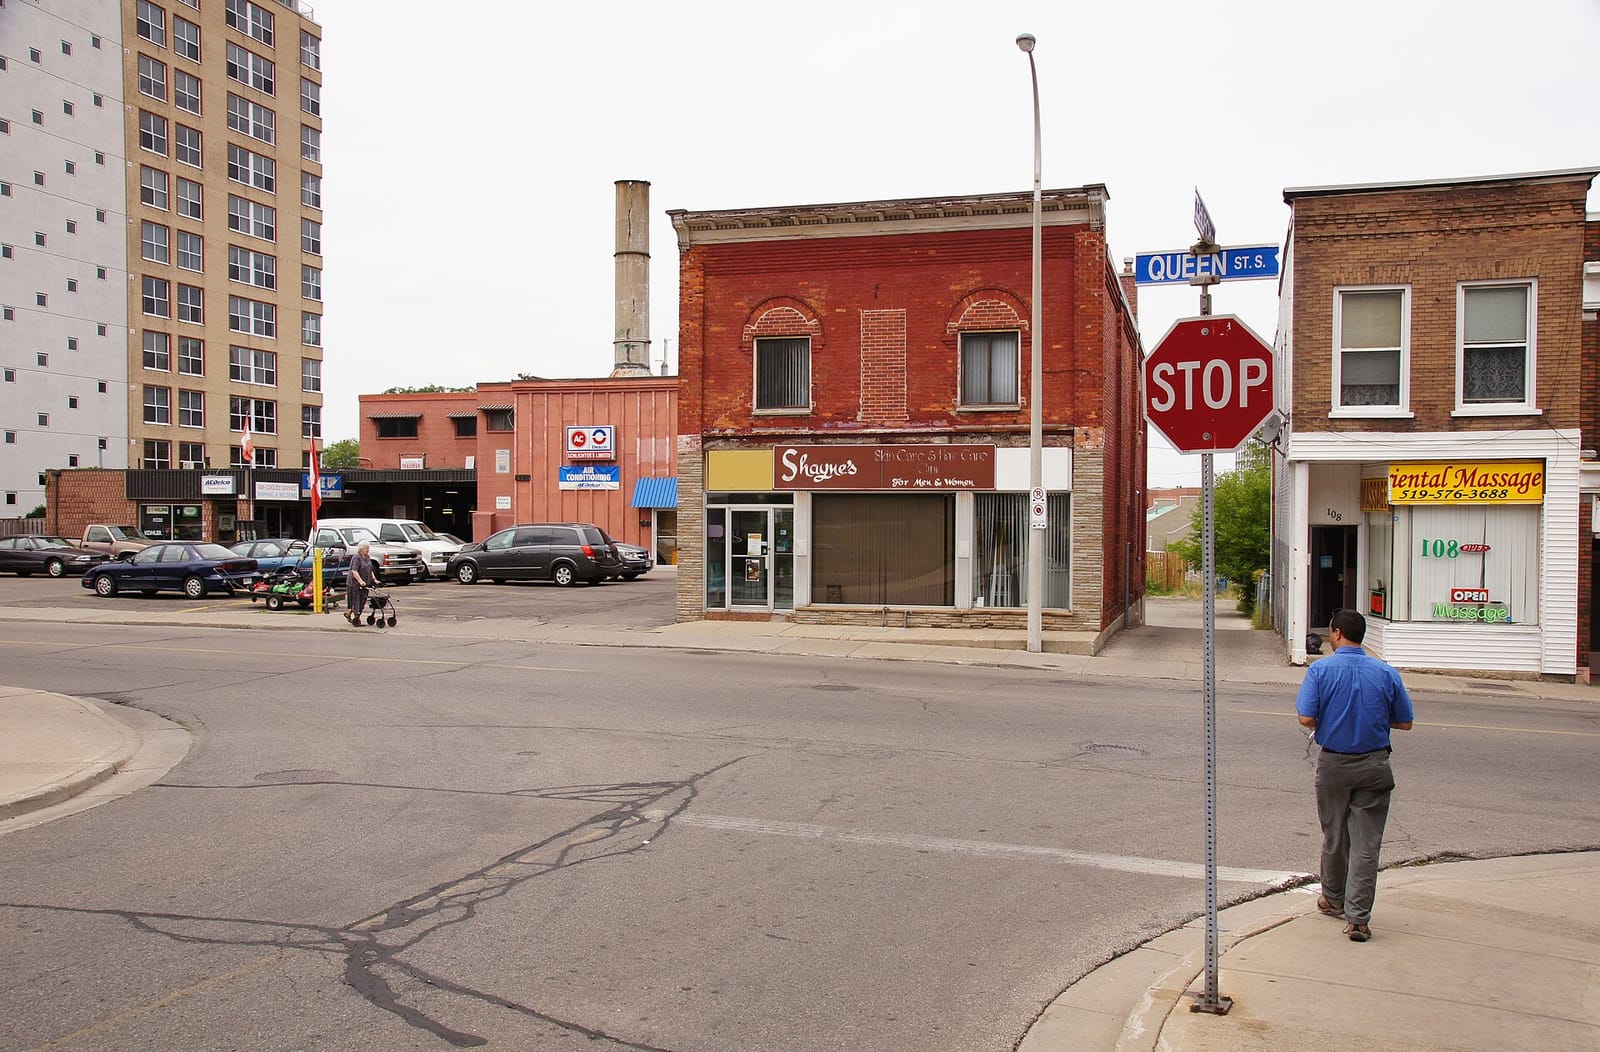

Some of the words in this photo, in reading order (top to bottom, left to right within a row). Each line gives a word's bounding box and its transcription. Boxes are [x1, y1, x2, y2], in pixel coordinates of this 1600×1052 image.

[1148, 251, 1227, 280] QUEEN
[1234, 256, 1252, 270] ST.
[1254, 254, 1266, 268] S.
[1151, 358, 1268, 412] STOP
[573, 434, 584, 443] AC
[781, 448, 858, 483] Shayne's
[566, 473, 612, 481] CONDITIONING
[892, 478, 909, 487] For
[913, 478, 932, 487] Men
[934, 478, 942, 487] &
[944, 478, 975, 487] Women
[1454, 468, 1542, 494] Massage
[1399, 489, 1509, 499] 519-576-3688
[1327, 508, 1342, 521] 108
[1421, 539, 1459, 558] 108
[1453, 591, 1487, 602] OPEN
[1433, 603, 1507, 623] Massage
